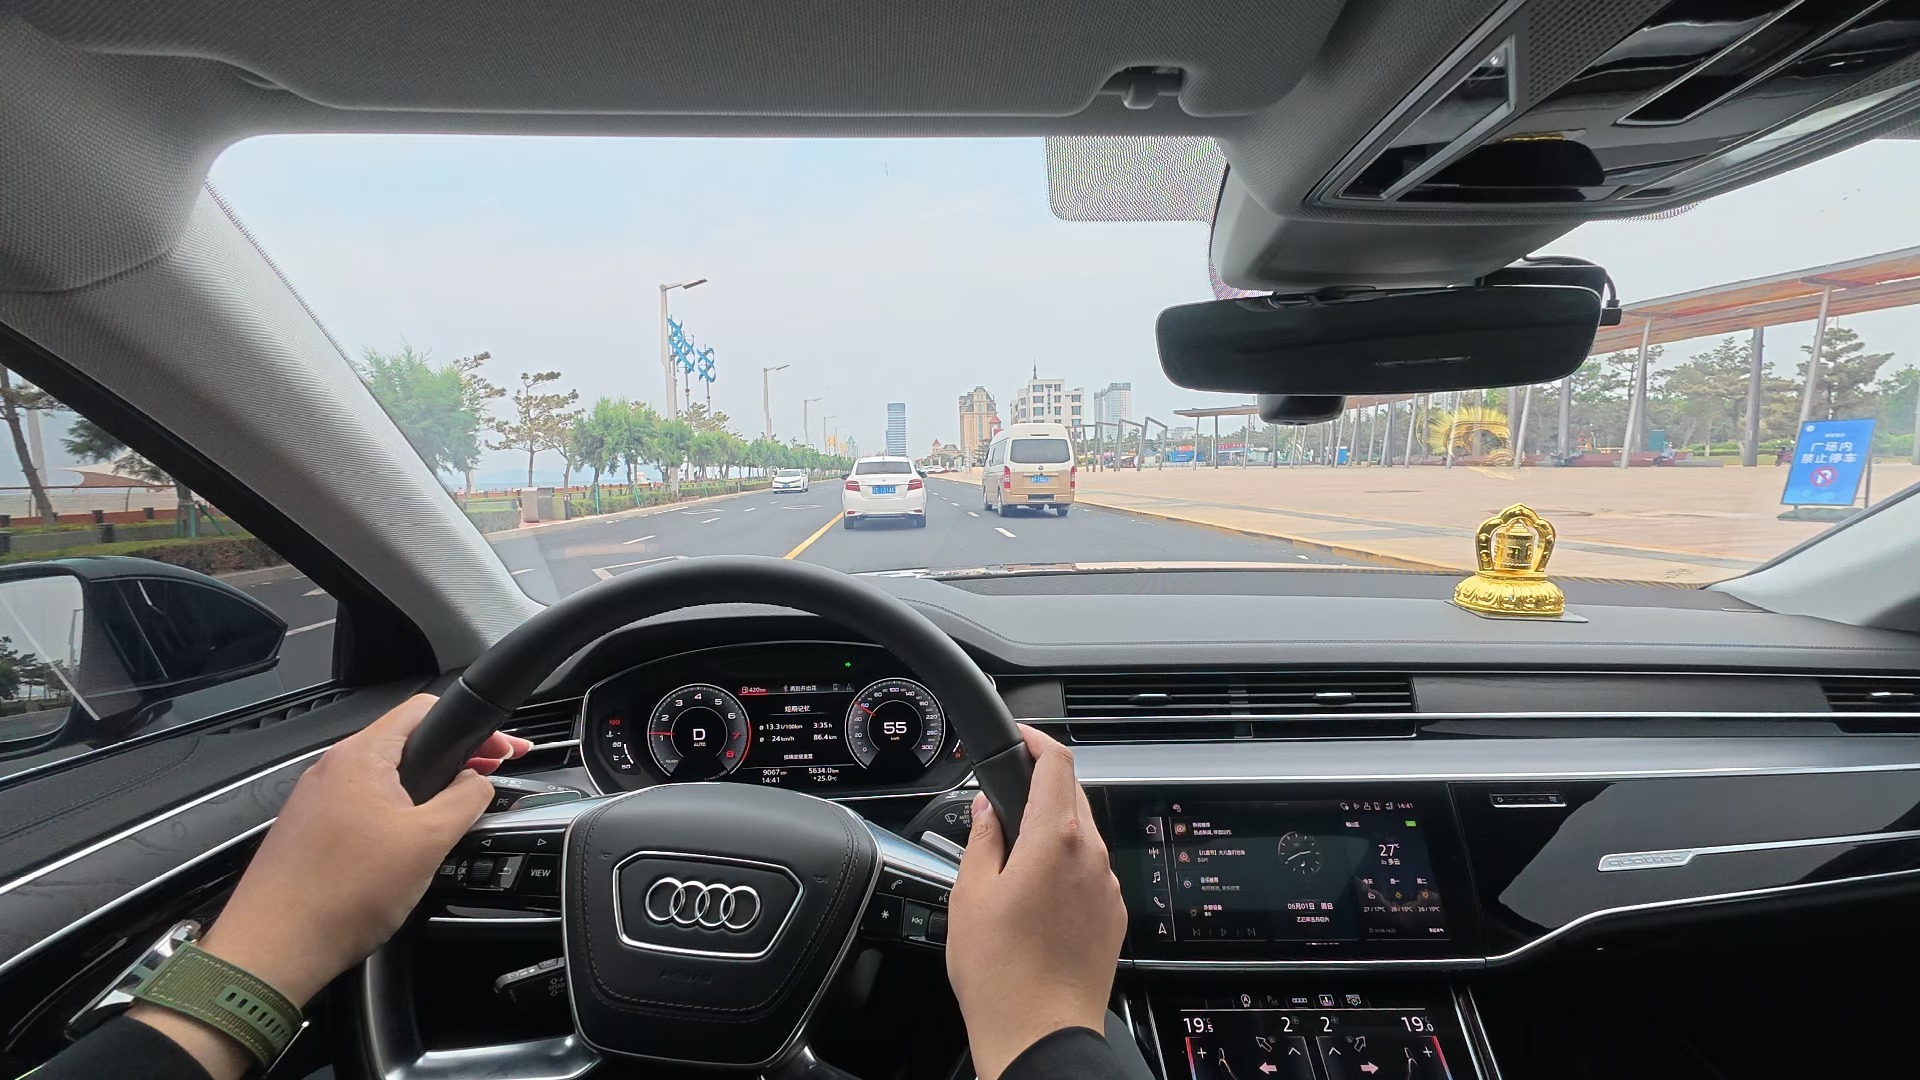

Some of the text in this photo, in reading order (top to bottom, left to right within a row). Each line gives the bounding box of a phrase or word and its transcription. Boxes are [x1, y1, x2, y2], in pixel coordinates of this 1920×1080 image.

[1810, 441, 1853, 453] 广场内
[1801, 452, 1857, 464] 禁止停车
[675, 699, 683, 707] 3
[714, 698, 722, 706] 5
[784, 705, 811, 713] 短期记忆
[883, 721, 907, 734] 55
[692, 728, 706, 741] D
[1608, 855, 1682, 867] quattro
[457, 867, 468, 875] OK
[530, 869, 552, 877] VIEW
[1287, 902, 1315, 910] 06月01日
[1280, 1016, 1293, 1032] 2
[1319, 1016, 1333, 1032] 2
